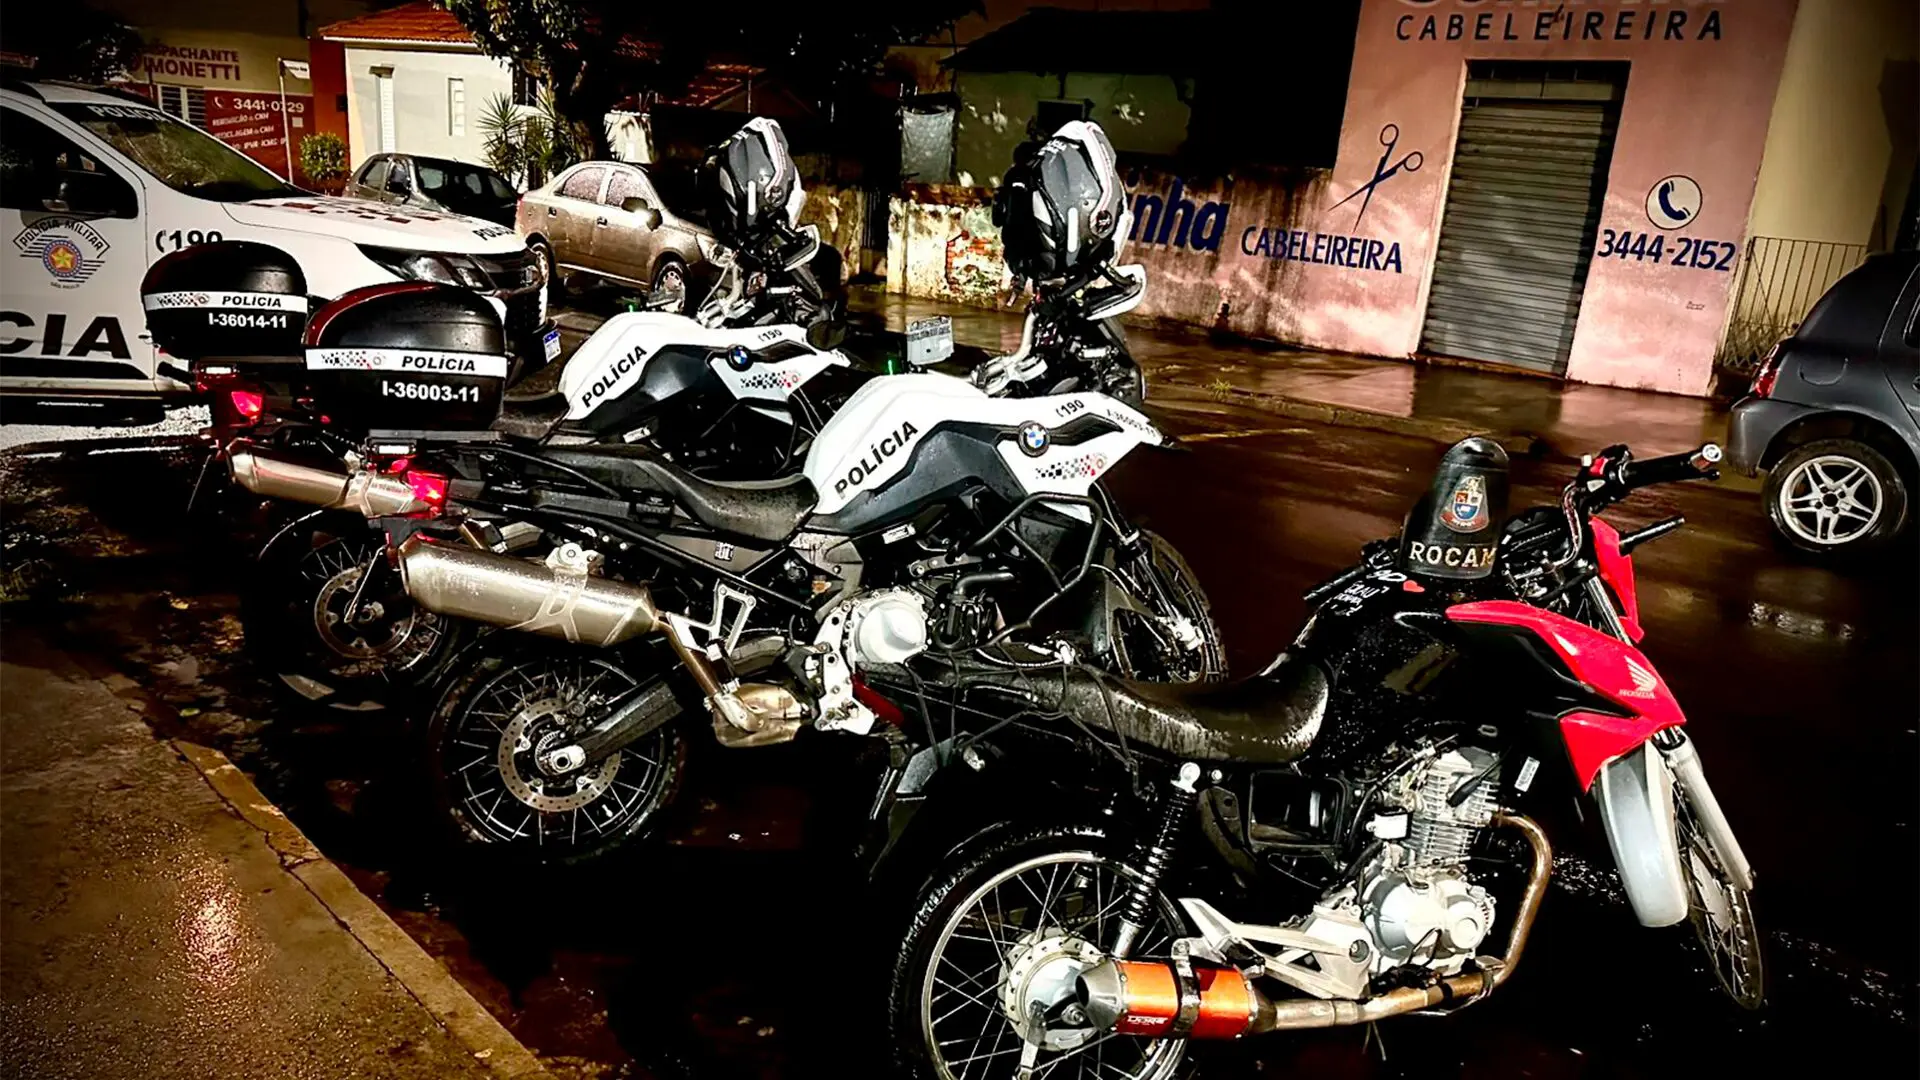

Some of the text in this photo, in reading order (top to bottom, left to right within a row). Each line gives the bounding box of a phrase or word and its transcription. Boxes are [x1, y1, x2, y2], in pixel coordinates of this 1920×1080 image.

[1396, 10, 1723, 41] CABELEIREIRA
[65, 219, 104, 251] MILITAR
[1241, 226, 1403, 273] CABELEIREIRA
[1597, 229, 1736, 272] 3444-2152
[222, 293, 282, 308] POLÍCIA
[208, 313, 288, 329] I-36014-11
[762, 329, 783, 340] 190
[401, 354, 476, 372] POLÍCIA
[581, 344, 647, 408] POLÍCIA
[382, 380, 480, 402] I-36003-11
[1061, 399, 1085, 415] 190
[834, 420, 919, 499] POLÍCIA
